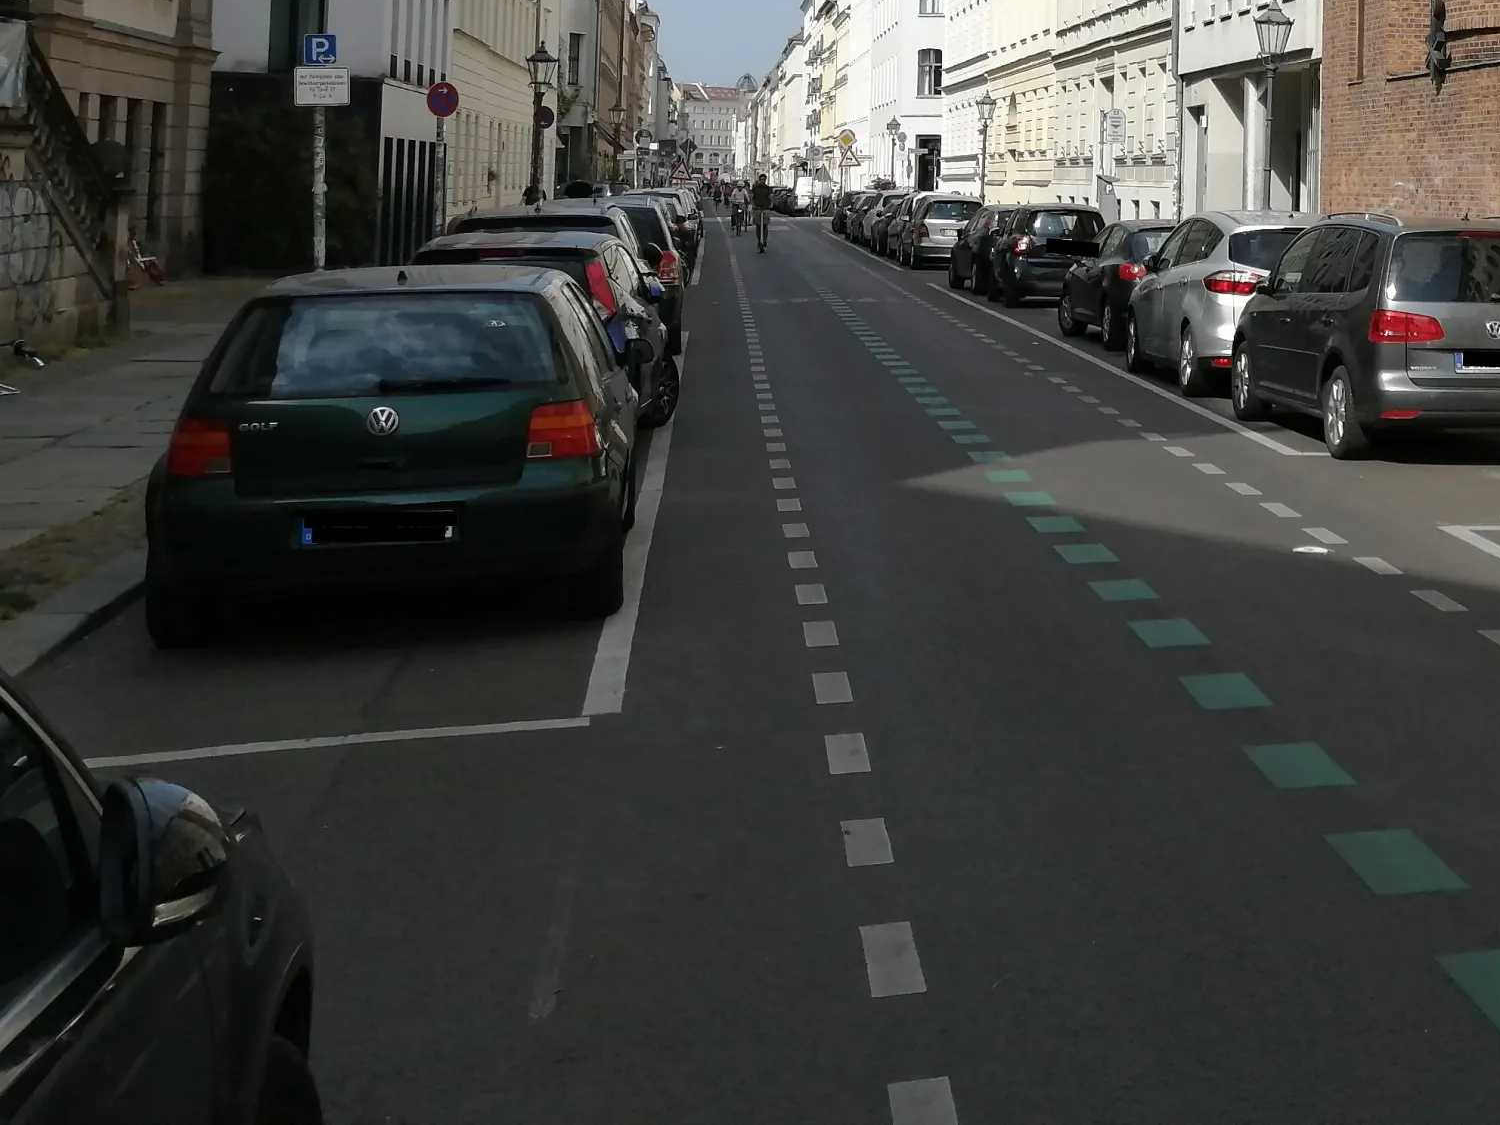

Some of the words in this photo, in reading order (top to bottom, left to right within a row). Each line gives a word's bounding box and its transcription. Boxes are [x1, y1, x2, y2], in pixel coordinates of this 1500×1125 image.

[312, 38, 329, 60] P
[1106, 184, 1112, 194] P
[238, 421, 279, 432] GOLF
